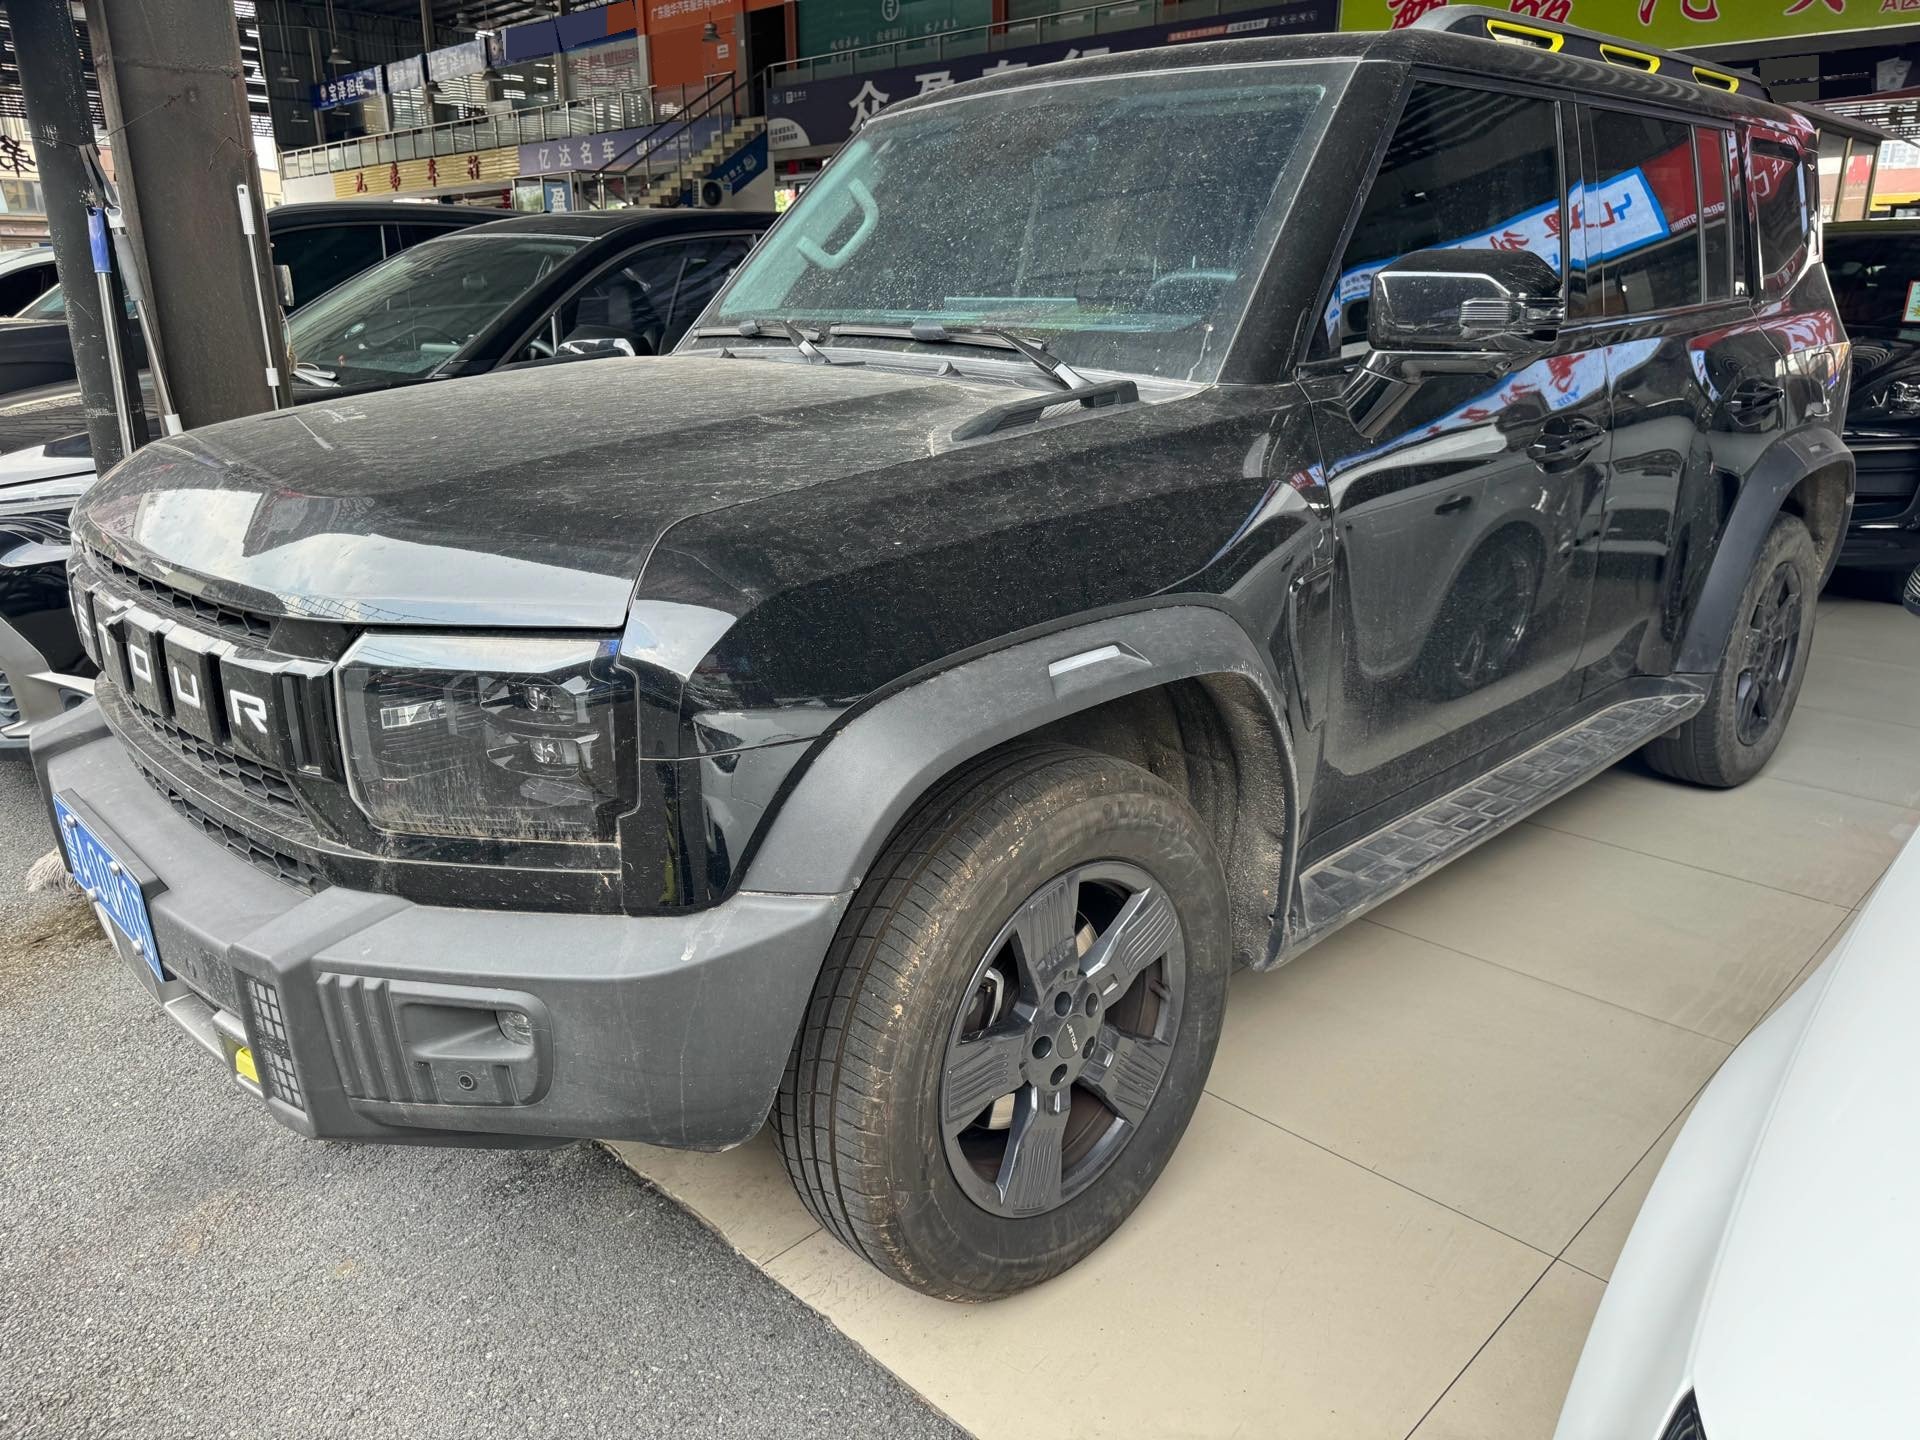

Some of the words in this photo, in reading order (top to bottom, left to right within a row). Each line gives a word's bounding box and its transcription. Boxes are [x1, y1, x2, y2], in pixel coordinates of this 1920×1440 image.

[538, 137, 617, 170] 亿达名车
[70, 592, 268, 734] ETOUR
